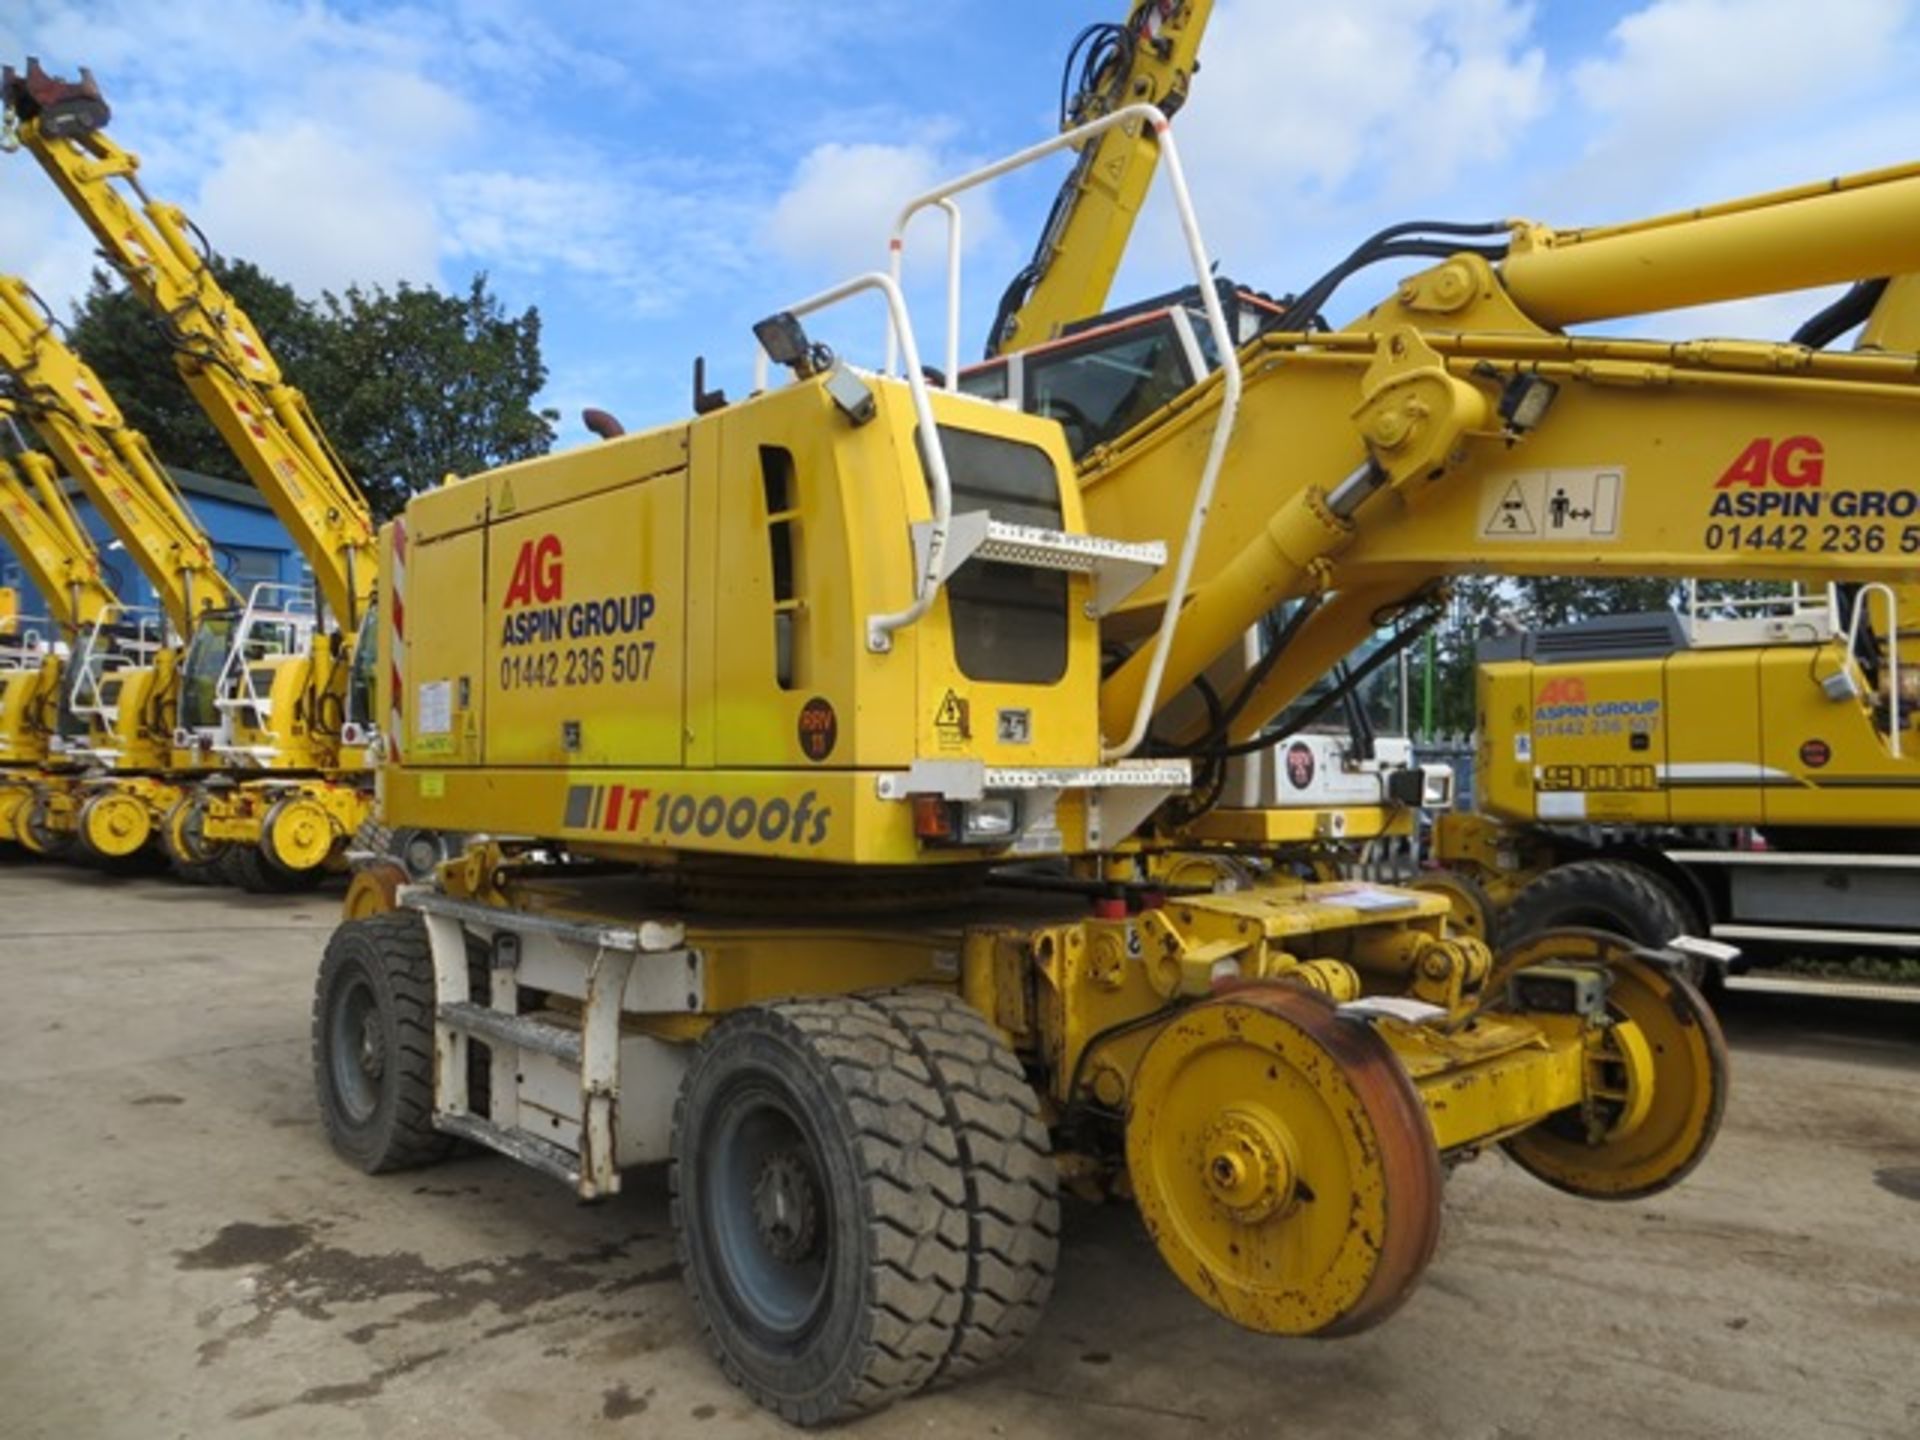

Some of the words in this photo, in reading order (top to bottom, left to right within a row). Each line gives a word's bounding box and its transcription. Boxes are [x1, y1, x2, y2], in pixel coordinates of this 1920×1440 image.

[1714, 435, 1824, 488] AG
[1709, 491, 1820, 517] ASPIN
[1830, 489, 1917, 518] GRO
[1706, 523, 1808, 551] 01442
[1821, 524, 1885, 553] 236
[1899, 525, 1920, 553] 5
[504, 533, 562, 609] AG
[502, 606, 562, 648] ASPIN
[569, 593, 655, 639] GROUP
[501, 652, 559, 691] 01442
[565, 647, 604, 685] 236
[612, 641, 655, 683] 507
[1536, 704, 1588, 719] ASPIN
[1593, 699, 1659, 716] GROUP
[654, 790, 831, 846] 10000fs
